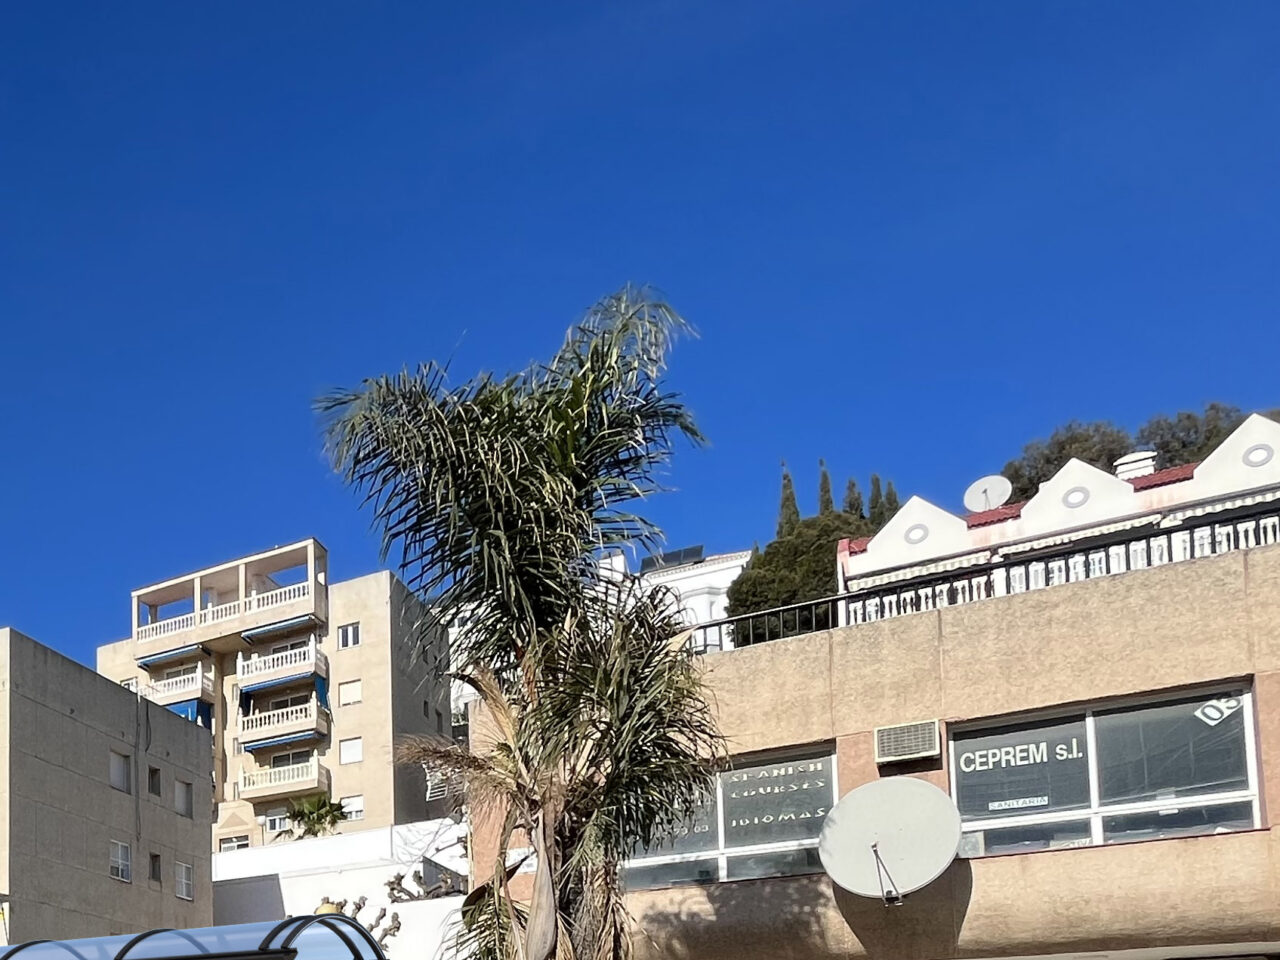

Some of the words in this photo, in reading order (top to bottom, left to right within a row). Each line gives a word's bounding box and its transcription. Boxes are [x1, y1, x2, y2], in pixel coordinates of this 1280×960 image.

[959, 741, 1049, 773] CEPREM
[1055, 737, 1083, 761] s.l.
[729, 762, 822, 783] SPANISH
[731, 778, 825, 799] COURSES
[989, 796, 1047, 810] SANITARIA
[731, 807, 826, 827] IDIOMAS
